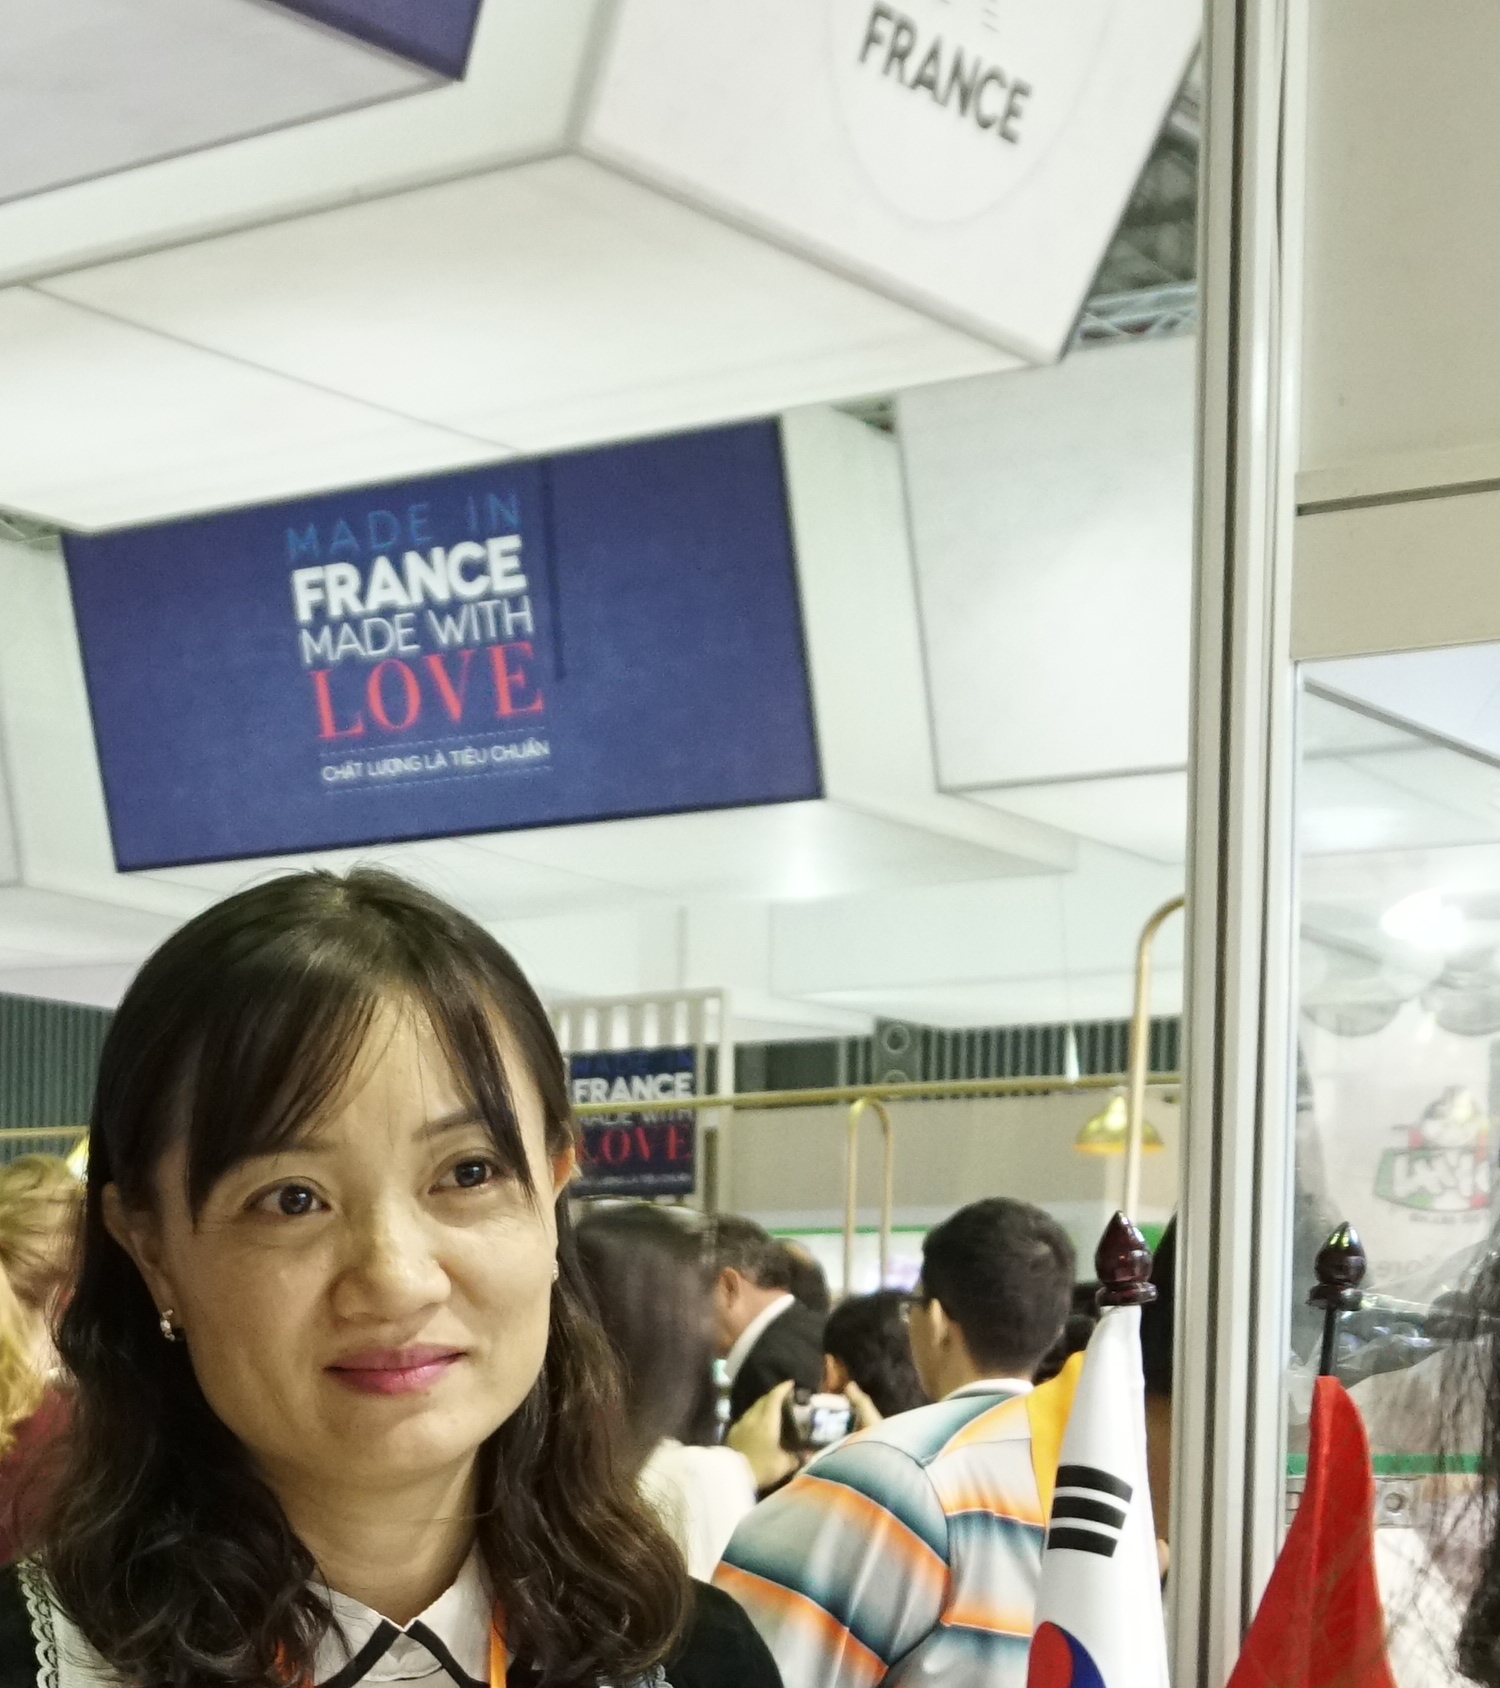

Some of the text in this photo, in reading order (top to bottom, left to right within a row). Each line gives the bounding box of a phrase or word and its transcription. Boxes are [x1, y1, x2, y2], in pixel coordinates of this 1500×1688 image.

[857, 0, 1033, 145] FRANCE
[284, 492, 521, 562] MADE IN
[292, 534, 529, 623] FRANCE
[300, 595, 534, 666] MADE WITH
[308, 640, 544, 740] LOVE
[572, 1071, 695, 1104] FRANCE
